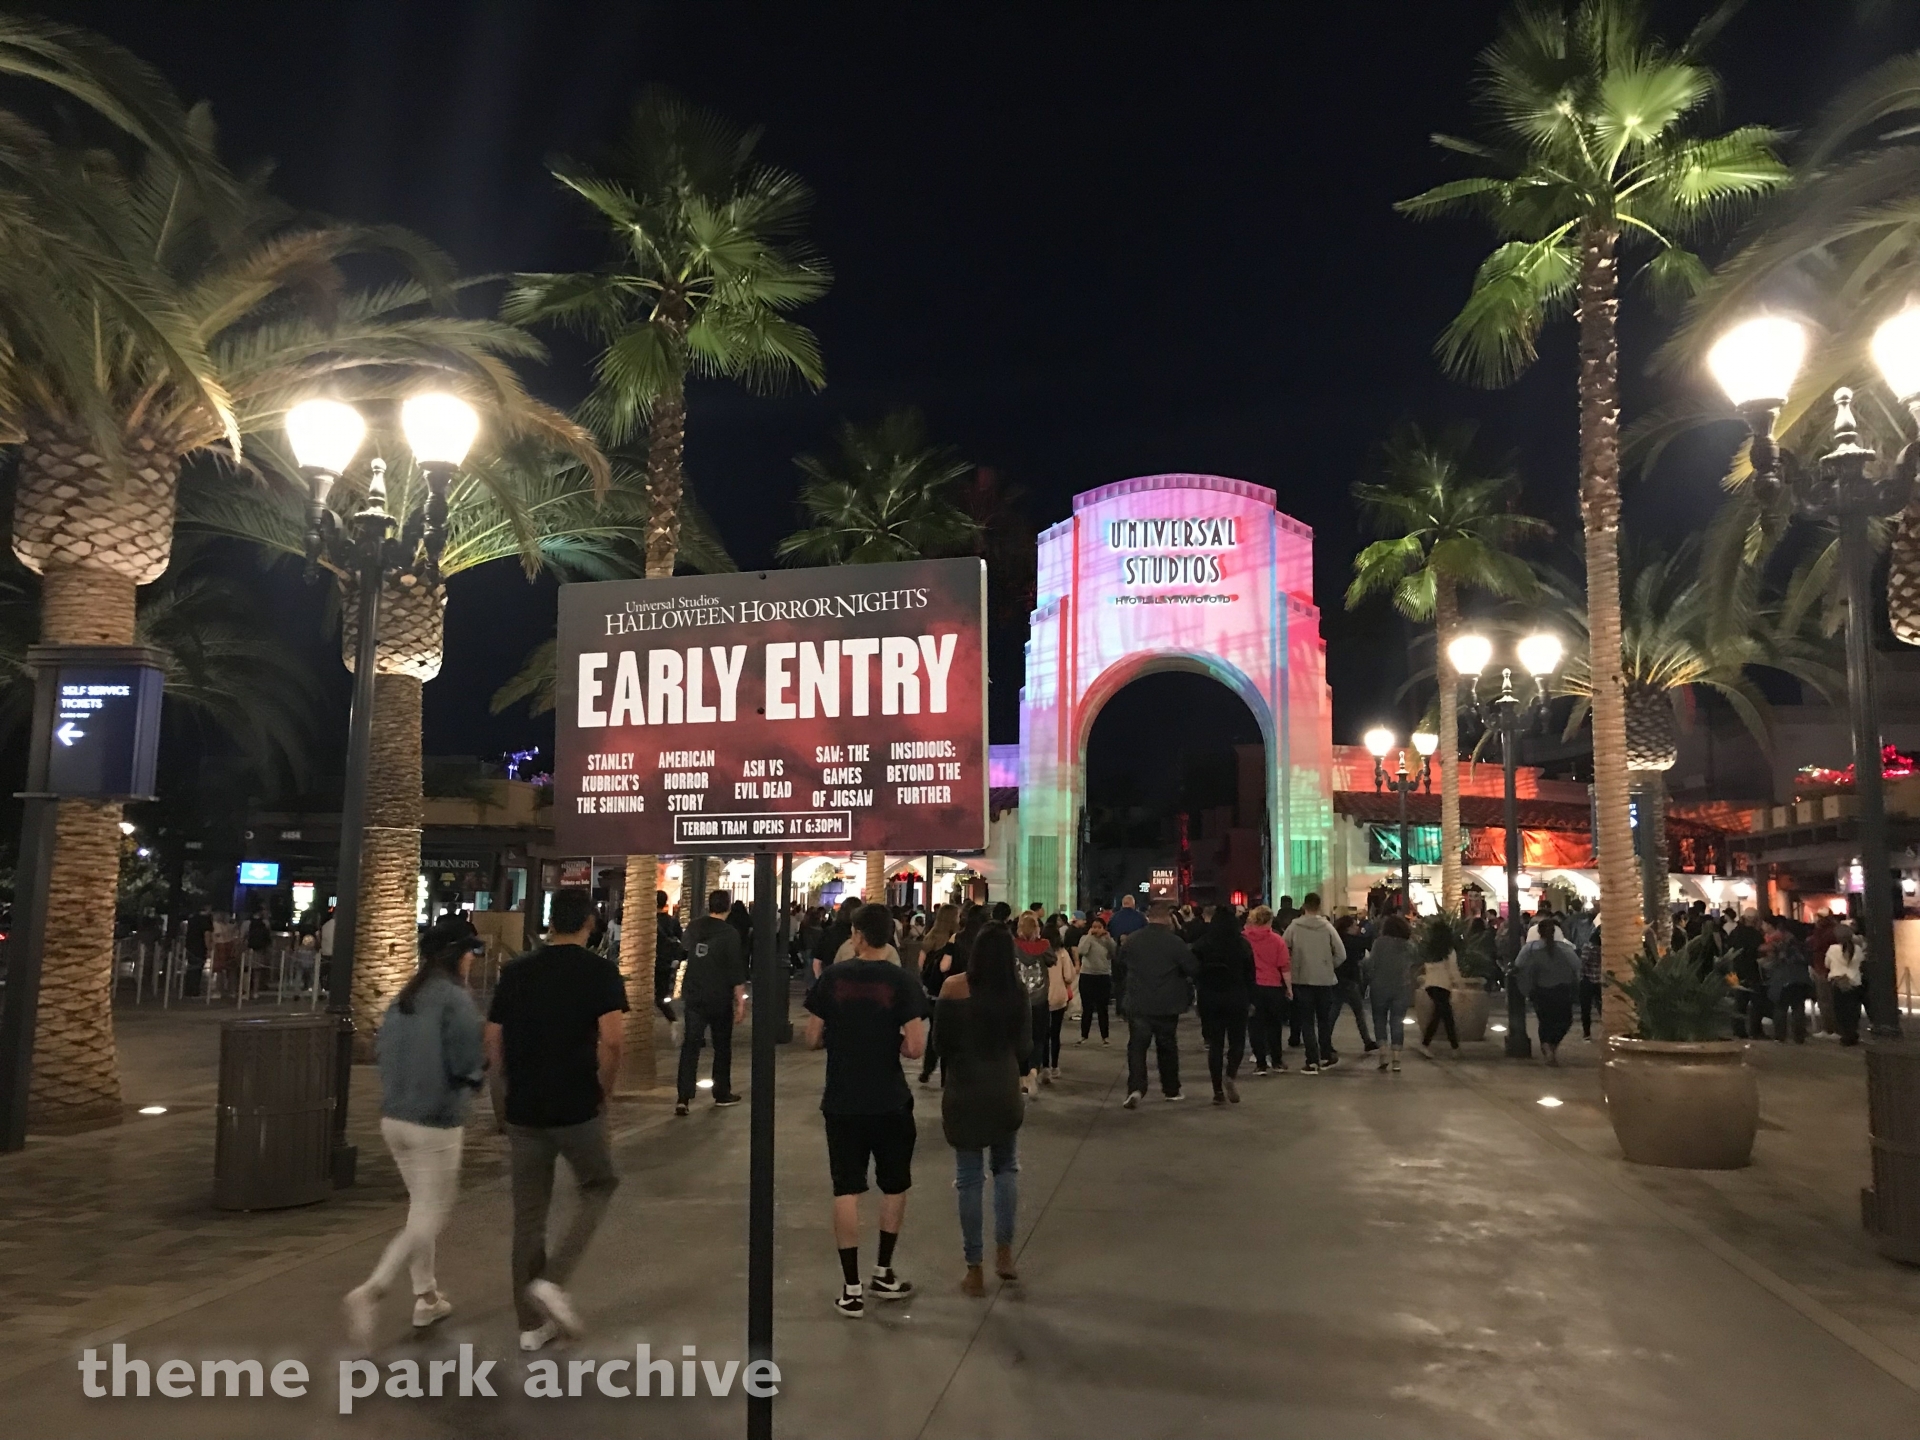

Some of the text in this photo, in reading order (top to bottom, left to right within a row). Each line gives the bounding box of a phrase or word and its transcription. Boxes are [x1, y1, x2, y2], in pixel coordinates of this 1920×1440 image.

[1111, 519, 1235, 549] UNIVERSAL
[1125, 556, 1220, 585] STUDIOS
[625, 594, 720, 613] Universal Studios
[1115, 596, 1231, 605] HOLLYWOOD
[605, 605, 735, 636] HALLOWEEN
[577, 633, 958, 728] EARLY ENTRY
[62, 686, 130, 695] SELF SERVICE
[61, 699, 103, 708] TICKETS
[658, 750, 715, 769] AMERICAN
[815, 744, 870, 763] SAW: THE
[890, 740, 957, 760] INSIDIOUS:
[587, 752, 634, 771] STANLEY
[743, 759, 784, 777] ASH VS
[664, 772, 709, 790] HORROR
[823, 768, 862, 786] GAMES
[886, 763, 961, 783] BEYOND THE
[582, 774, 640, 793] KUBRICK'S
[734, 780, 792, 800] EVIL DEAD
[577, 795, 645, 814] THE SHINING
[667, 793, 704, 812] STORY
[812, 788, 873, 808] OF JIGSAW
[897, 786, 951, 805] FURTHER
[682, 818, 843, 836] TERROR TRAM OPENS AT 6:30PM
